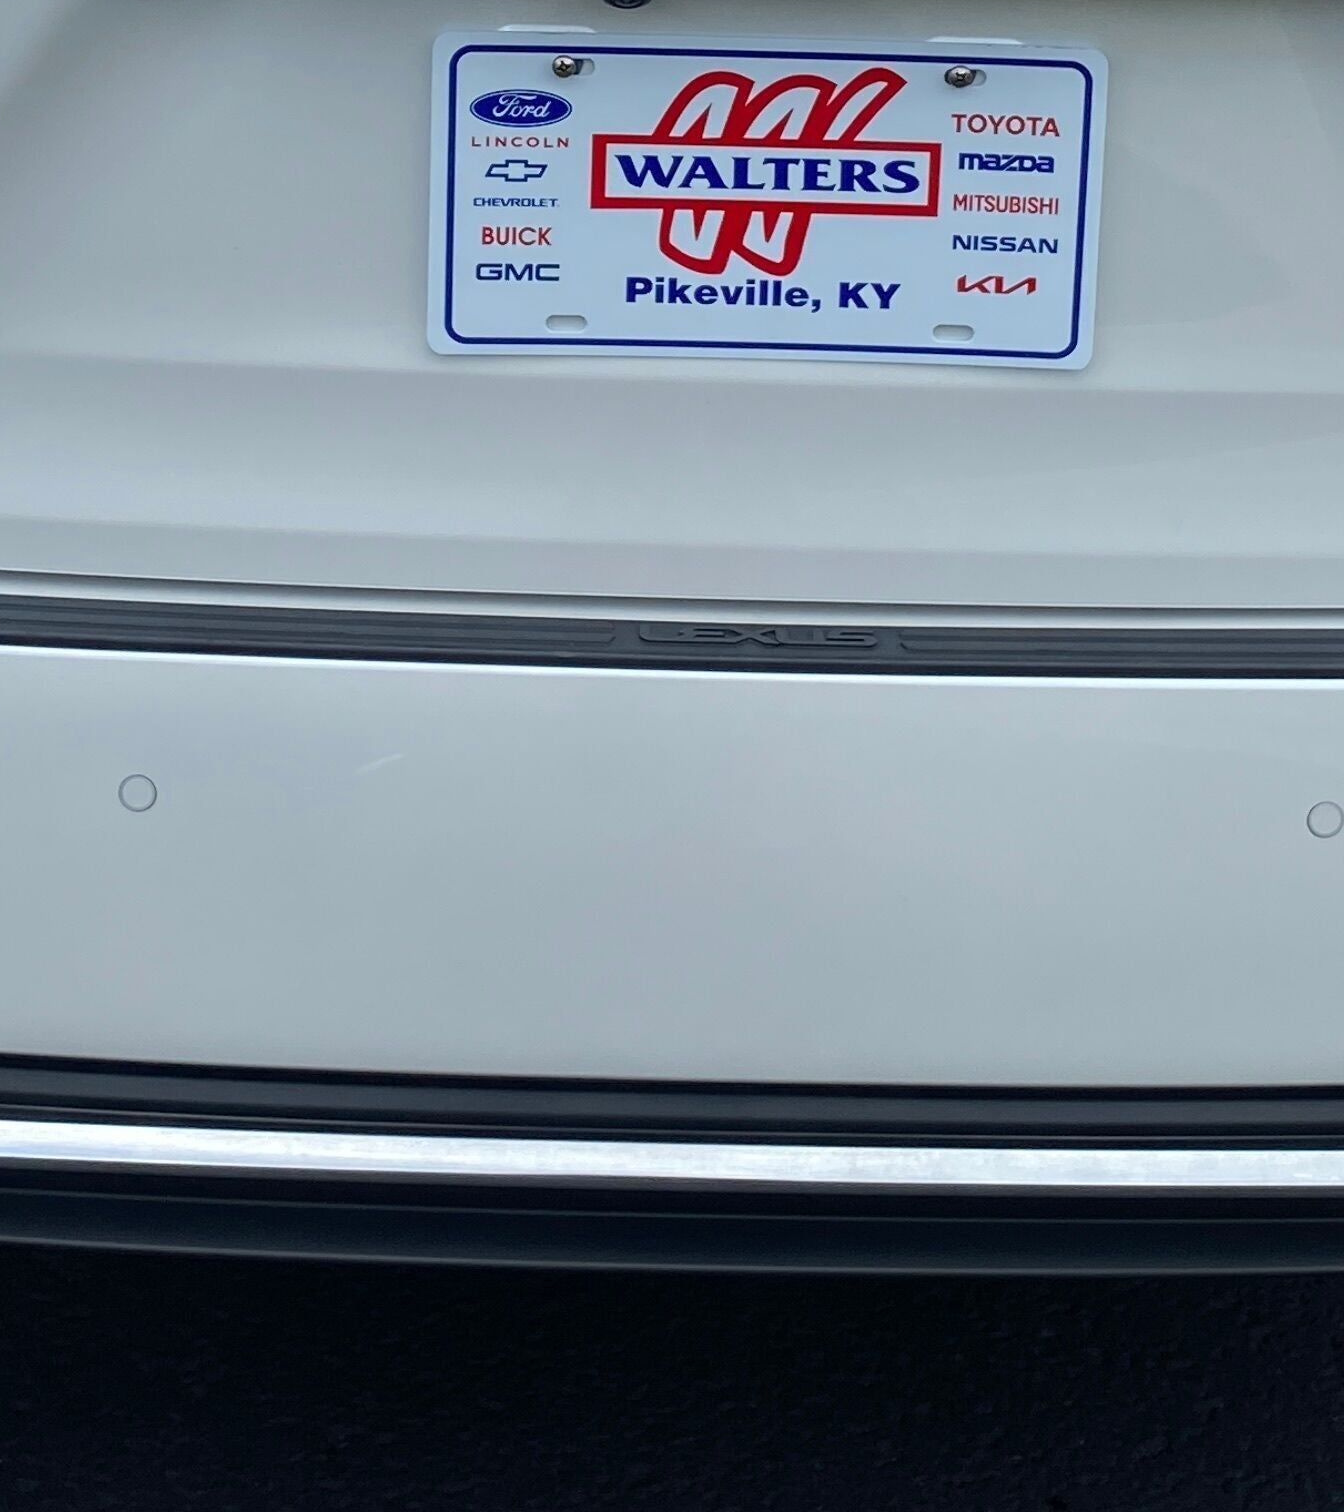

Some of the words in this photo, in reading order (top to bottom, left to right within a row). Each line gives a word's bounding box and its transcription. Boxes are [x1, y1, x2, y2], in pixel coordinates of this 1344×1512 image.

[492, 94, 552, 118] Ford
[951, 113, 1060, 137] TOYOTA
[471, 135, 570, 148] LINCOLN
[615, 154, 920, 194] WALTERS
[473, 197, 559, 207] CHEVROLET
[953, 193, 1059, 215] MITSUBISHI
[481, 226, 552, 246] BUICK
[952, 234, 1059, 254] NISSAN
[476, 263, 560, 281] GMC
[626, 277, 821, 313] Pikeville,
[838, 282, 901, 309] KY
